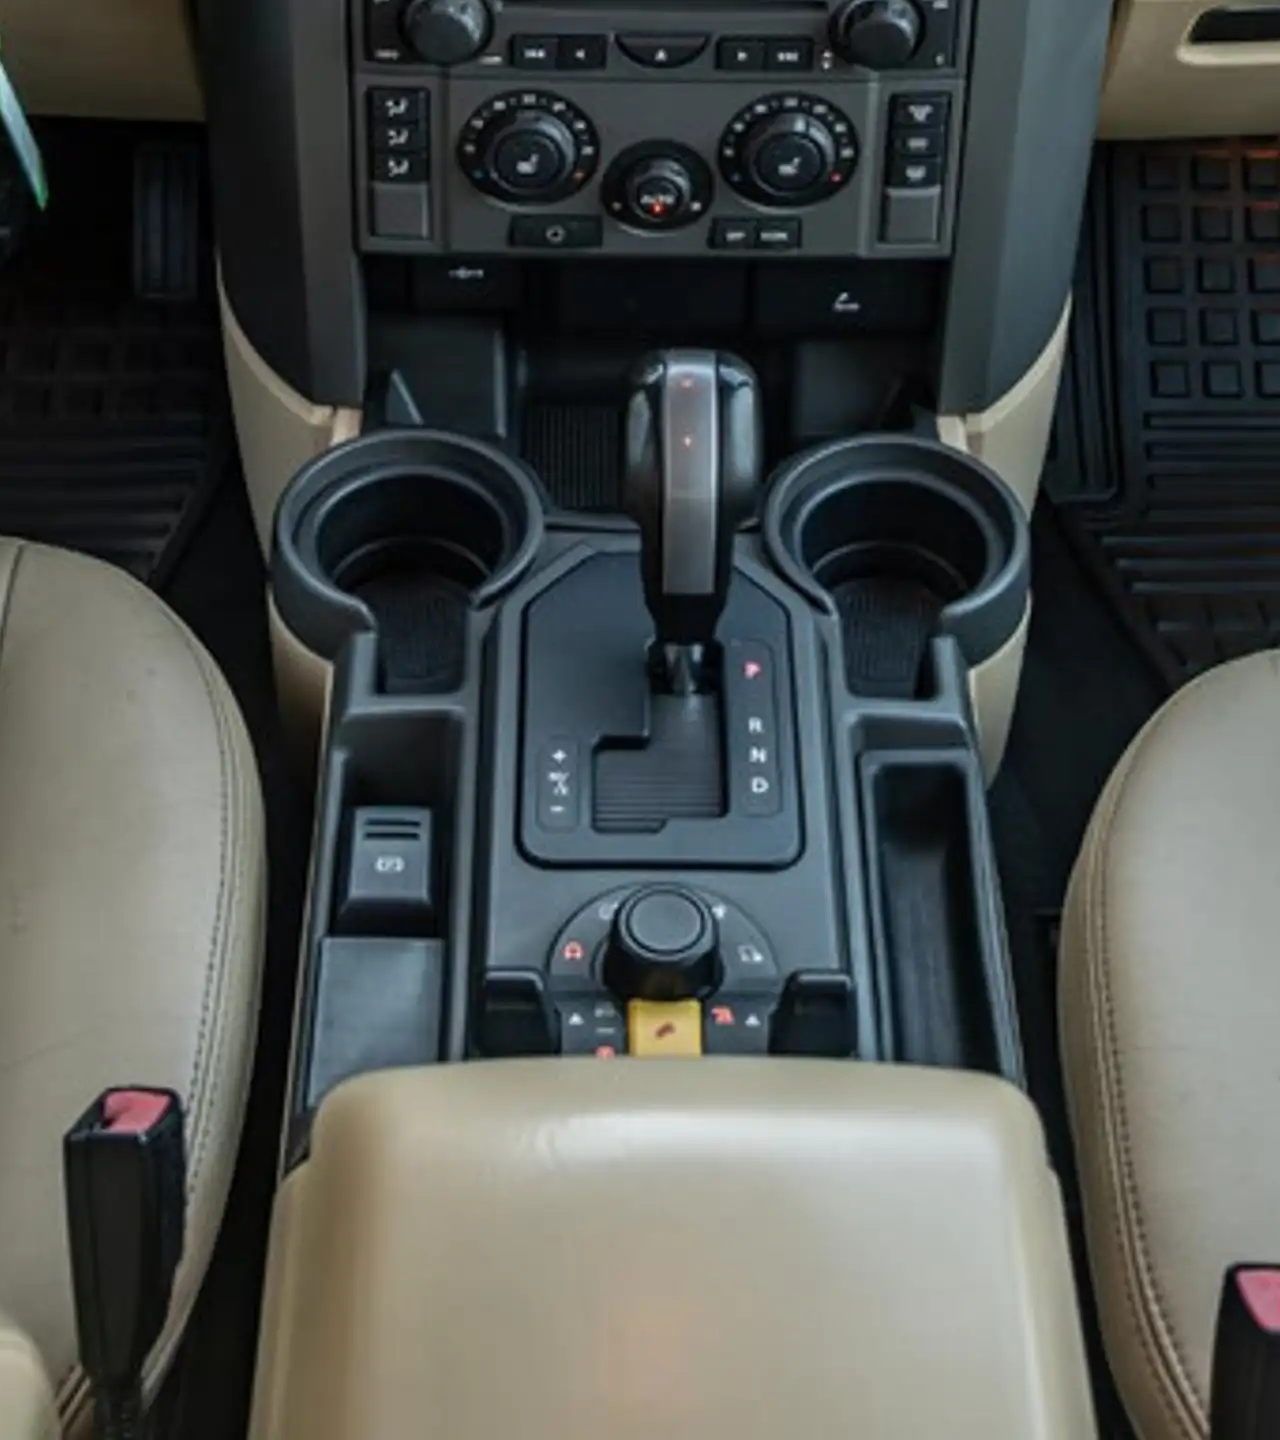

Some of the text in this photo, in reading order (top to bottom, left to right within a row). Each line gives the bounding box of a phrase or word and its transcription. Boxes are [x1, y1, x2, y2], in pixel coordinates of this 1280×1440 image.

[743, 662, 762, 679] P
[748, 716, 764, 734] R
[748, 746, 768, 764] N
[751, 775, 769, 794] D
